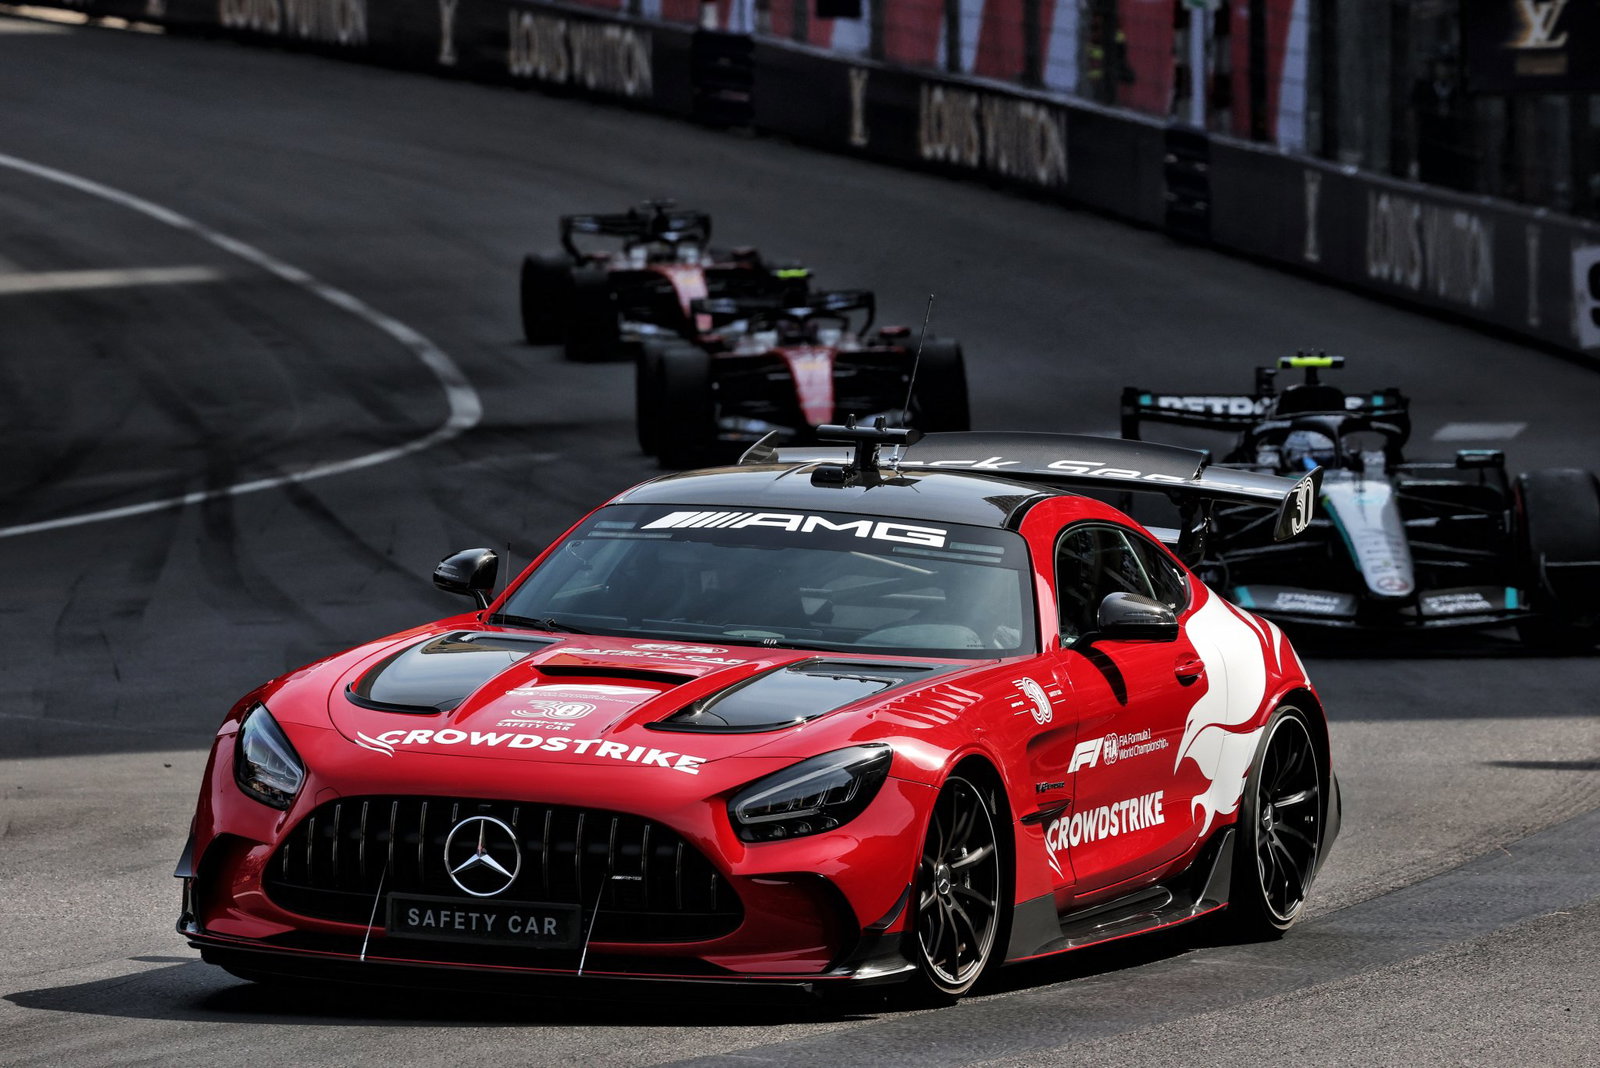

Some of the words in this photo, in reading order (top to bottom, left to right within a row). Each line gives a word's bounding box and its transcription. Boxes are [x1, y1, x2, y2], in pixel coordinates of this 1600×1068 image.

[742, 512, 947, 548] AMG
[495, 721, 543, 729] SAFETY
[375, 729, 707, 775] CROWDSTRIKE
[1119, 745, 1134, 760] World
[1046, 790, 1165, 852] CROWDSTRIKE
[408, 907, 497, 932] SAFETY
[508, 915, 558, 936] CAR
